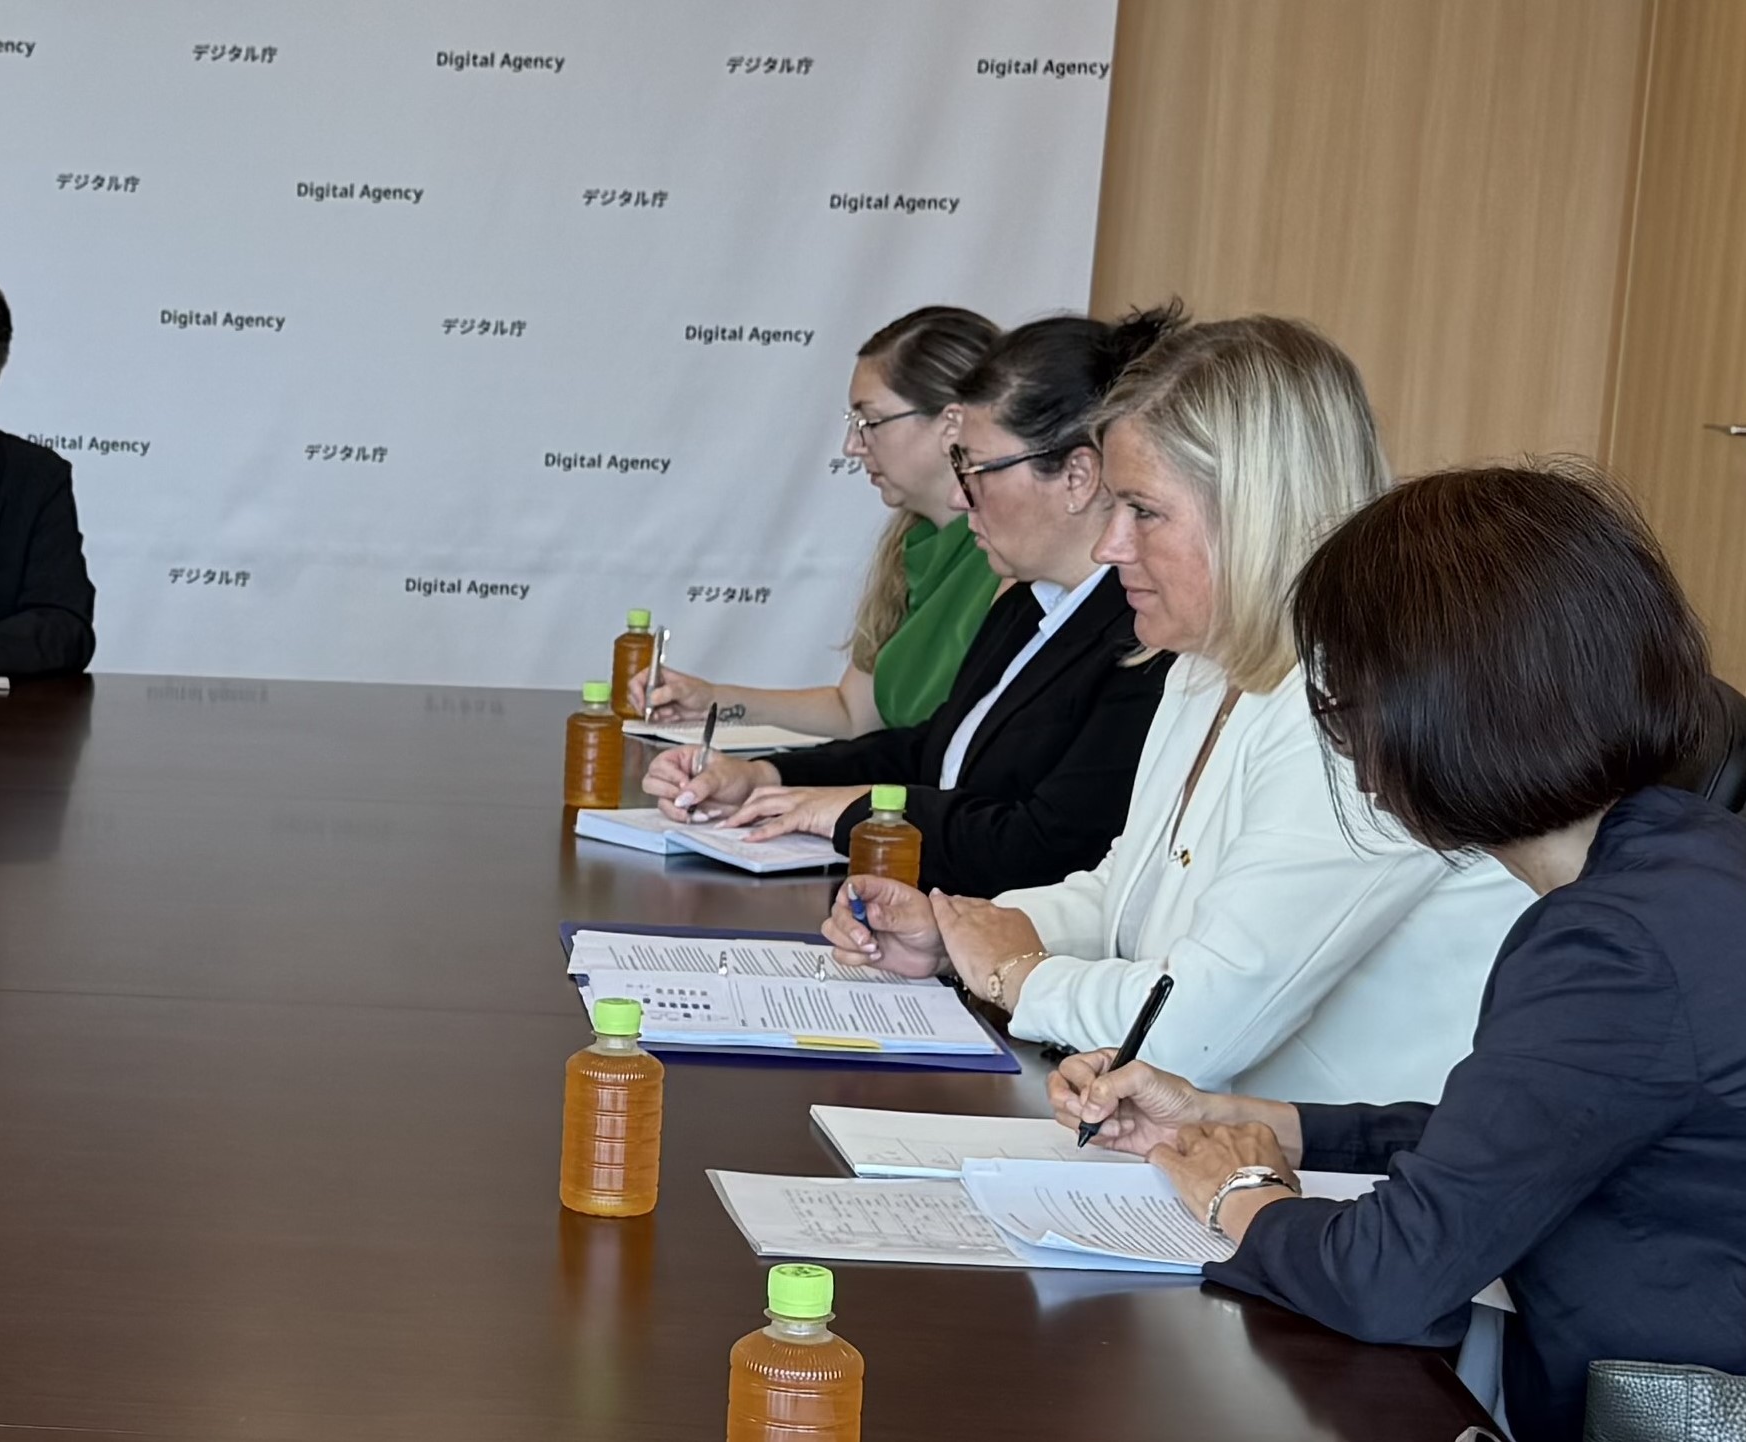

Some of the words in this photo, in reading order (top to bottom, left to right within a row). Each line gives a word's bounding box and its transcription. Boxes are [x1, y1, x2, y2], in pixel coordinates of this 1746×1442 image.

[192, 43, 278, 64] デジタル庁
[436, 50, 496, 72] Digital
[499, 52, 566, 74] Agency
[726, 55, 815, 76] デジタル庁
[976, 57, 1039, 80] Digital
[1042, 58, 1110, 80] Agency
[55, 172, 141, 194] デジタル庁
[296, 181, 355, 203] Digital
[358, 183, 425, 205] Agency
[582, 188, 669, 209] デジタル庁
[829, 192, 890, 215] Digital
[893, 193, 961, 215] Agency
[160, 309, 218, 330] Digital
[221, 311, 286, 333] Agency
[441, 317, 527, 338] デジタル庁
[684, 324, 744, 346] Digital
[747, 326, 816, 347] Agency
[87, 436, 151, 458] Agency
[304, 443, 389, 464] デジタル庁
[544, 452, 603, 473] Digital
[606, 454, 672, 475] Agency
[168, 567, 251, 588] デジタル庁
[404, 577, 462, 598] Digital
[466, 579, 531, 601] Agency
[686, 585, 772, 605] デジタル庁
